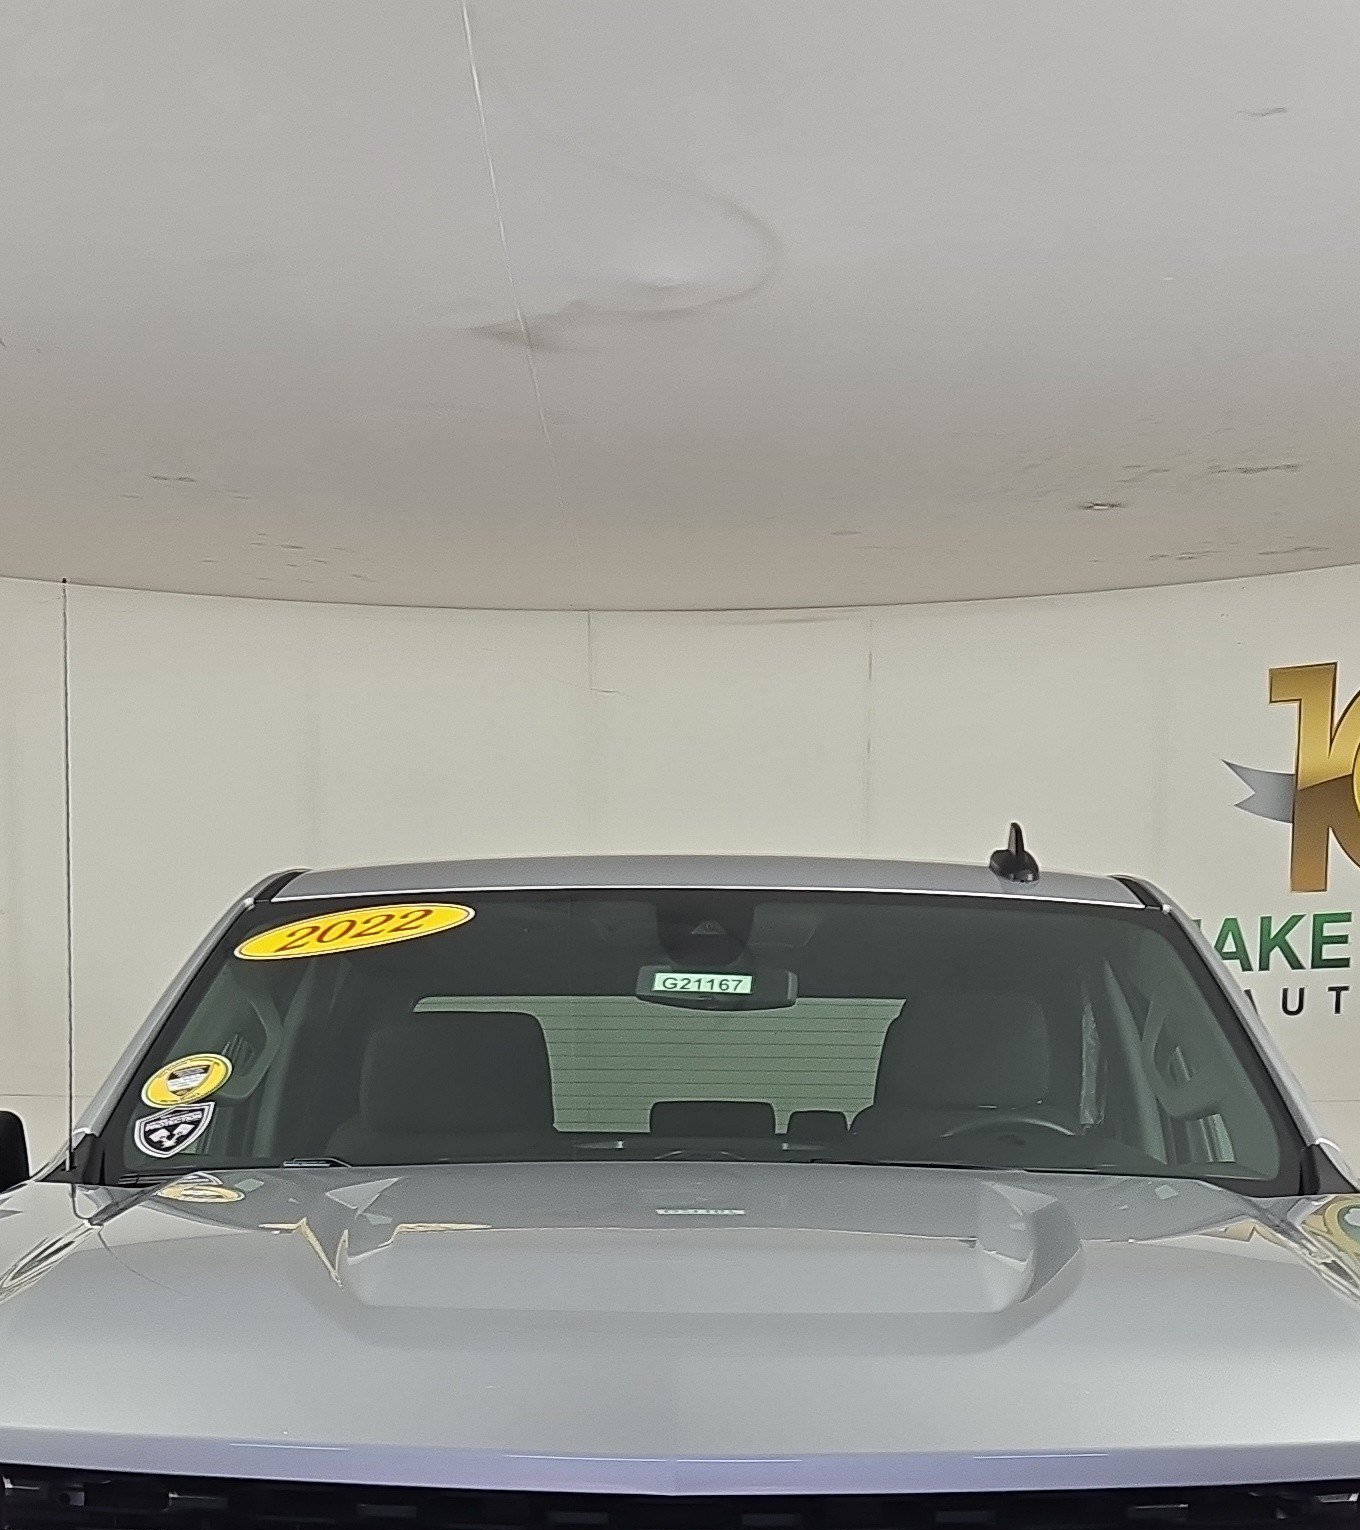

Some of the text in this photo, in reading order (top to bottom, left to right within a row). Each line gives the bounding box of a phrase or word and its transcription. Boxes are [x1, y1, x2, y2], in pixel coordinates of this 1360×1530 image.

[273, 909, 434, 953] 2022
[1191, 911, 1353, 972] AKE
[662, 977, 744, 992] G21167
